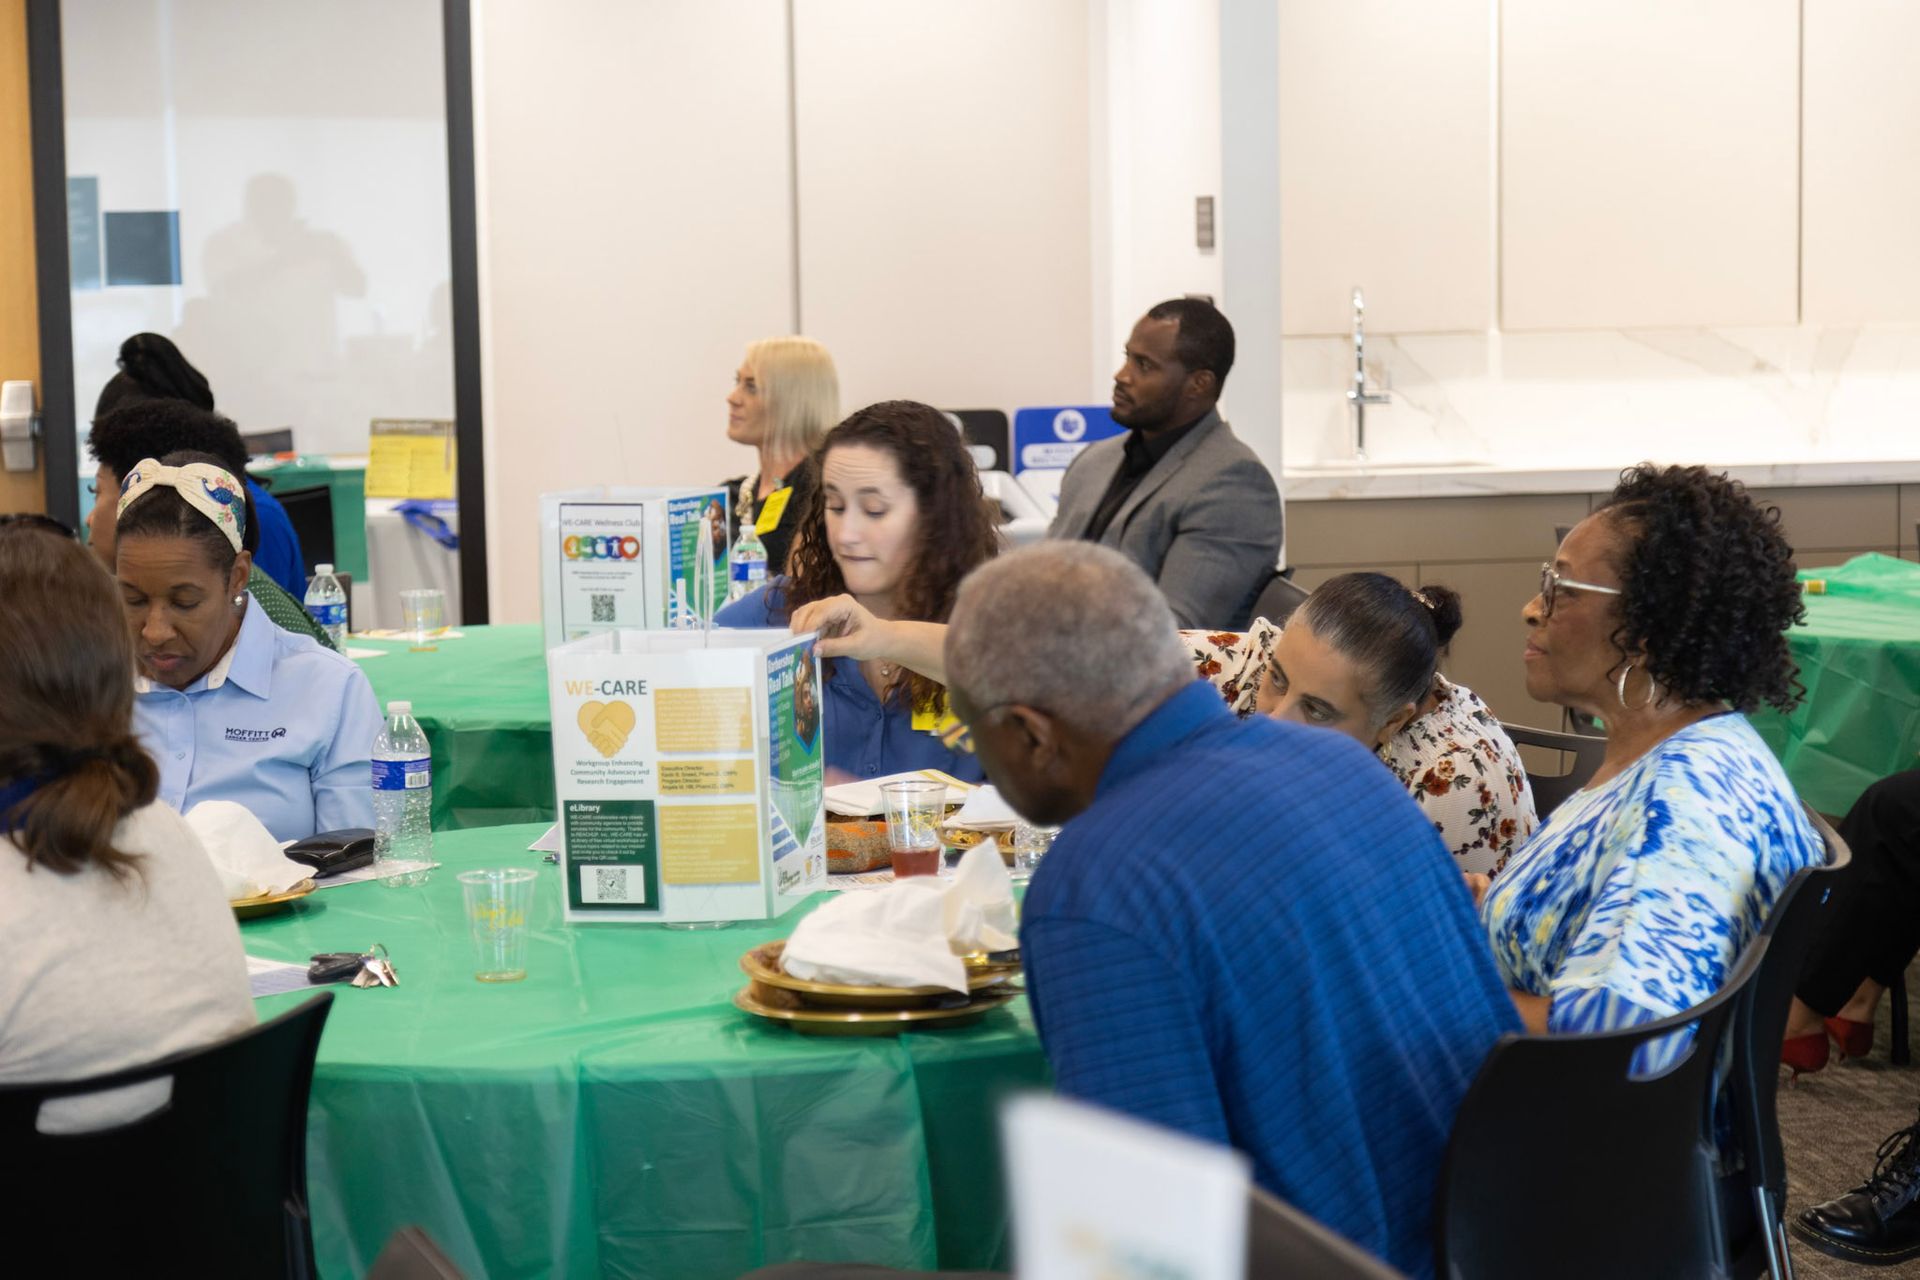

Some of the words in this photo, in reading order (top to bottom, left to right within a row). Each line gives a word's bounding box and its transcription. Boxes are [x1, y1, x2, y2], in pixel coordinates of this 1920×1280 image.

[595, 518, 623, 526] Wellness
[625, 518, 640, 526] Club
[565, 680, 648, 696] WE-CARE
[225, 728, 270, 737] MOFFITT
[576, 760, 610, 768] Workgroup
[612, 759, 644, 768] Enhancing
[570, 769, 606, 777] Community
[608, 768, 636, 776] Advocacy
[570, 804, 600, 814] eLibrary
